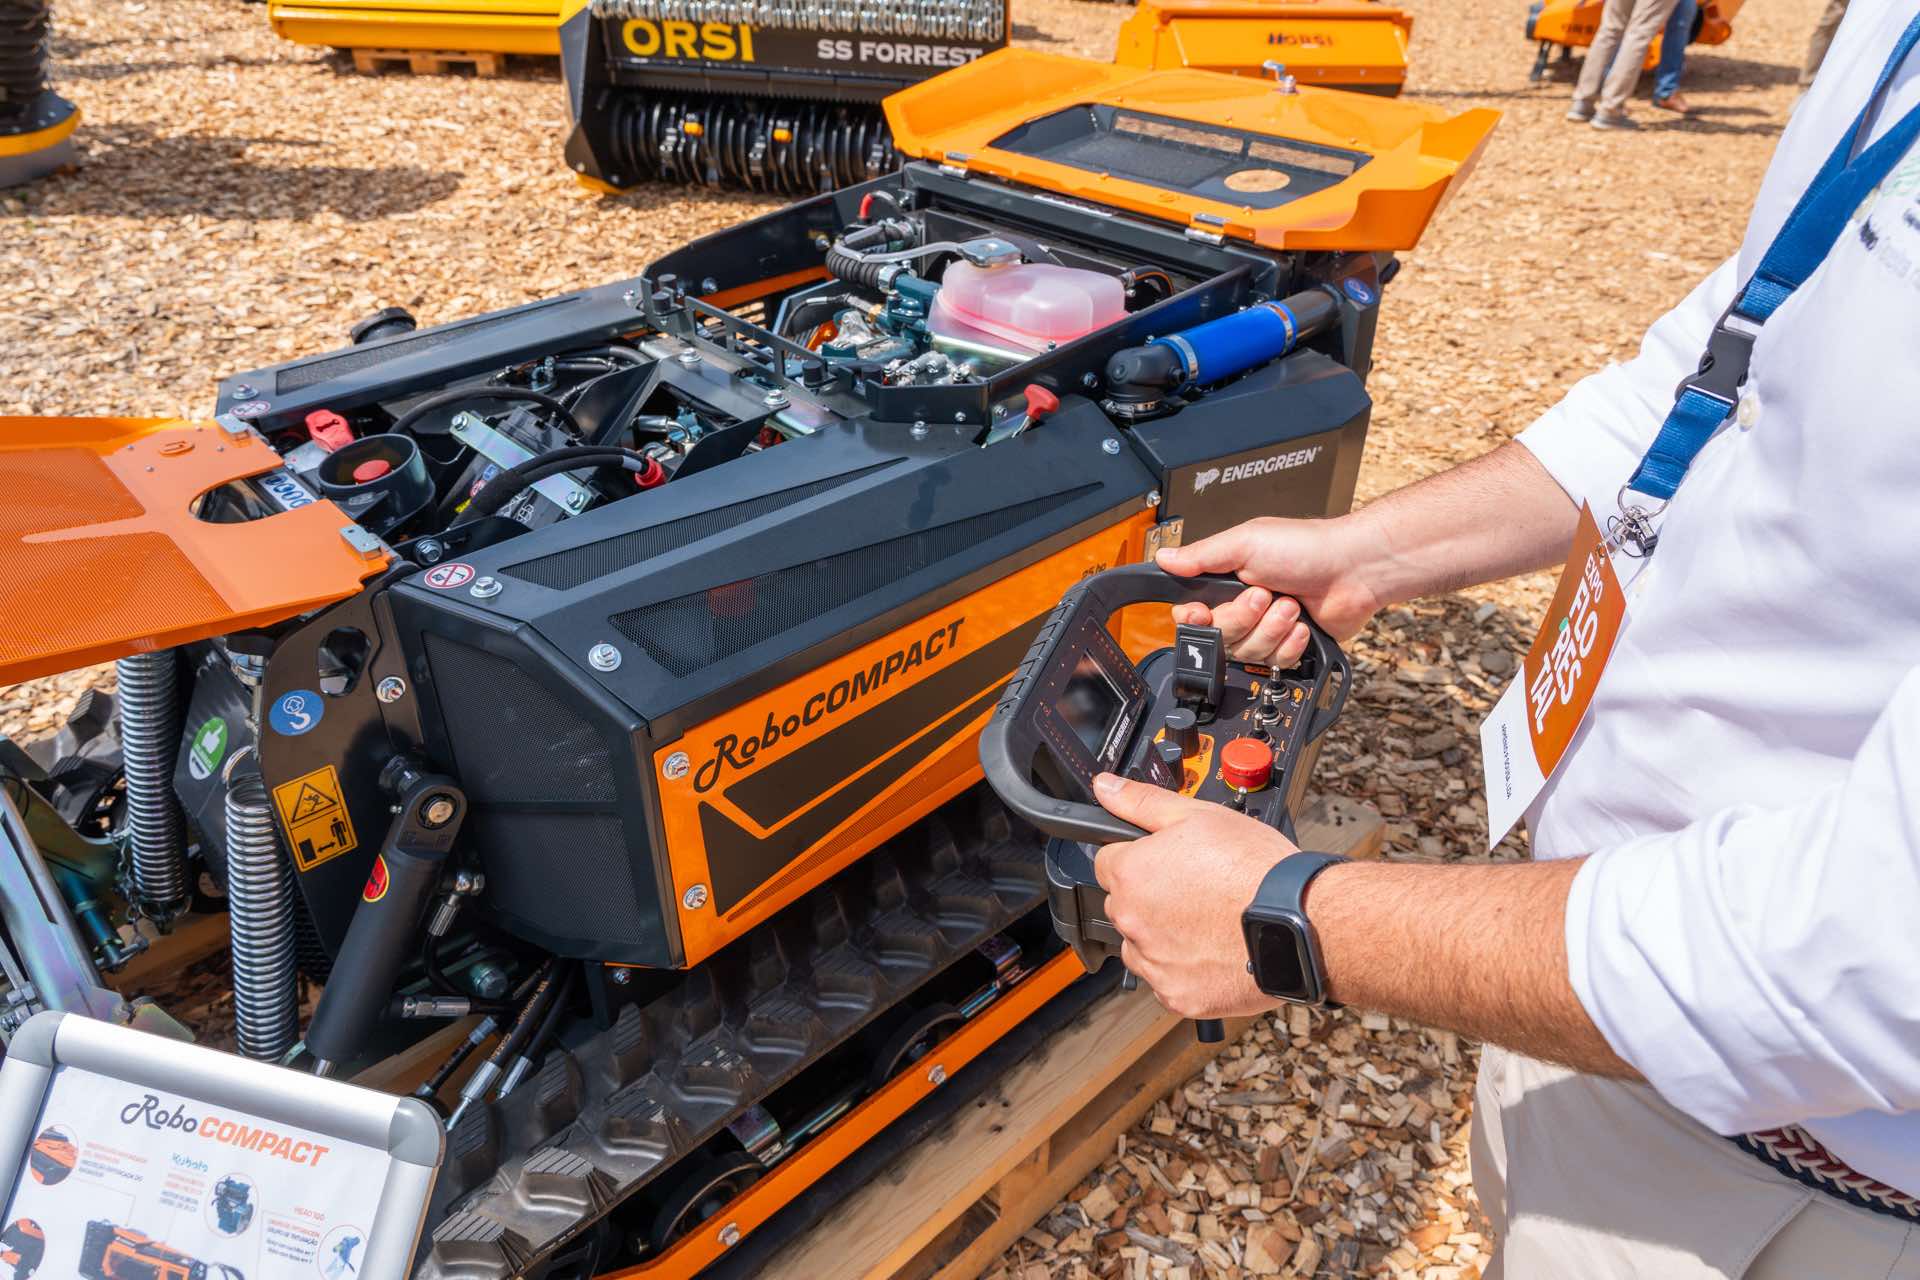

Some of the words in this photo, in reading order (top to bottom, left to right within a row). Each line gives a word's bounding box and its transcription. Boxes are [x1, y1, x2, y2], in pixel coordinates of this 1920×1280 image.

[622, 18, 755, 62] ORSI
[817, 39, 854, 61] SS
[860, 41, 983, 66] FORREST
[1220, 447, 1317, 484] ENERGREEN
[1585, 552, 1604, 604] EXPO
[1569, 576, 1598, 659] FLO
[1530, 651, 1557, 735] TAL
[1552, 620, 1582, 705] RES
[693, 617, 965, 794] RoboCOMPACT
